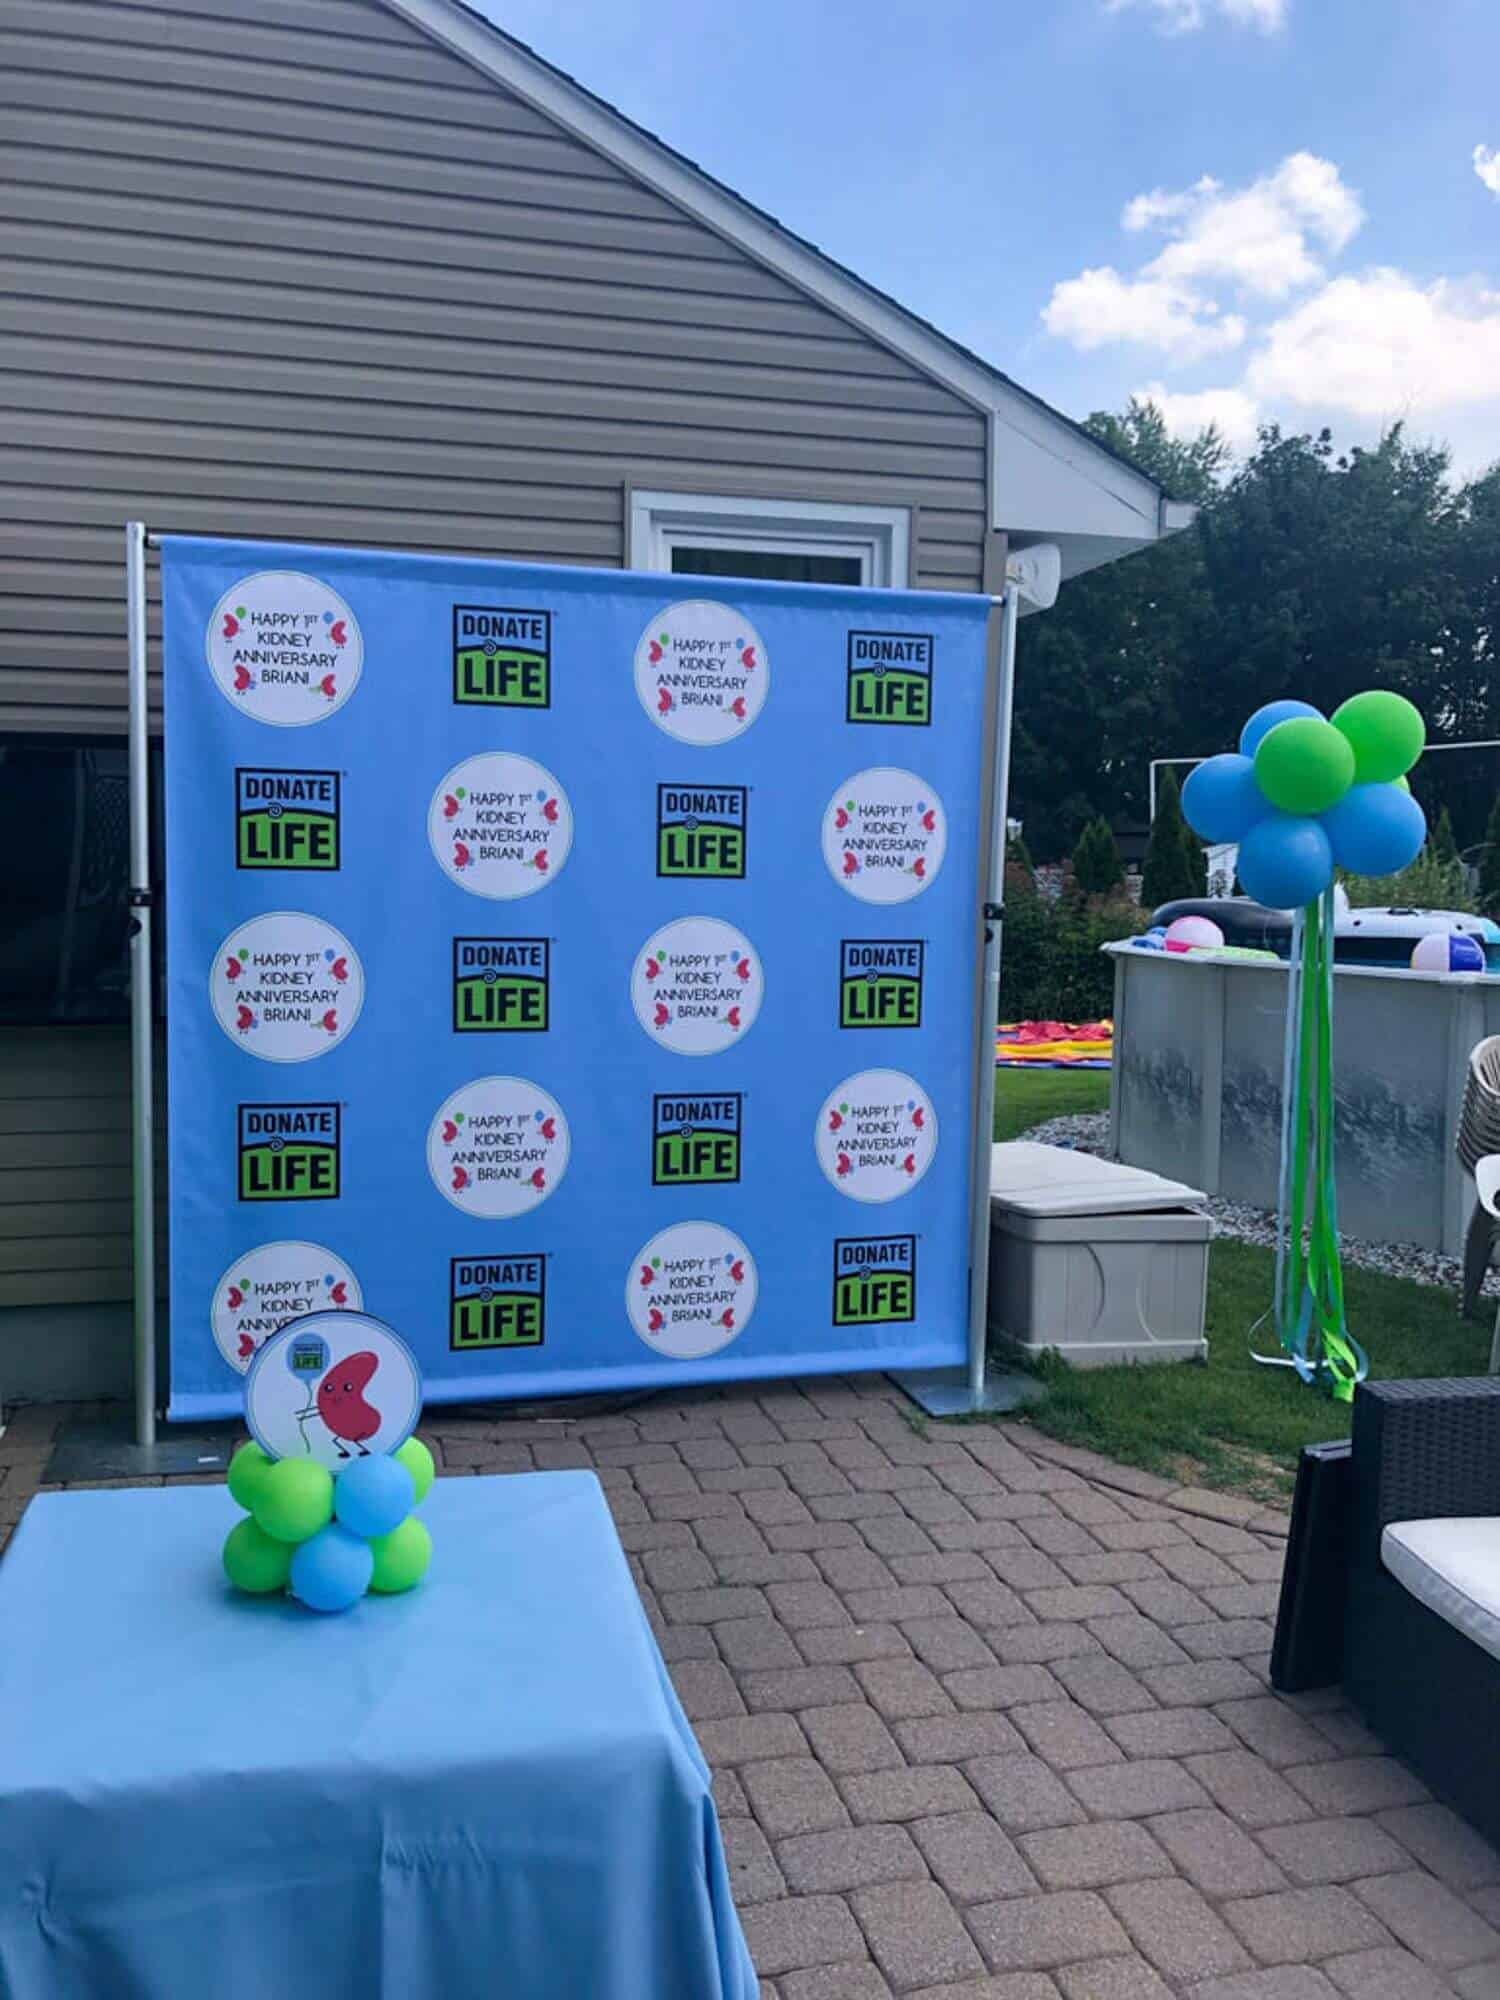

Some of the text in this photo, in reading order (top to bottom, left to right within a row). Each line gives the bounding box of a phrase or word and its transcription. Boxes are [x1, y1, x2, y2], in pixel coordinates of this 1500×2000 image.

[250, 612, 299, 626] HAPPY
[463, 615, 542, 640] DONATE
[257, 632, 312, 647] KIDNEY
[672, 639, 719, 652] HAPPY
[232, 649, 338, 667] ANNIVERSARY
[856, 640, 926, 662] DONATE
[678, 657, 726, 671] KIDNEY
[464, 658, 542, 697] LIFE
[656, 674, 747, 689] ANNIVERSARY
[856, 679, 924, 716] LIFE
[245, 777, 331, 800] DONATE
[469, 792, 514, 805] HAPPY
[666, 793, 739, 814] DONATE
[476, 812, 526, 824] KIDNEY
[858, 805, 897, 817] HAPPY
[453, 828, 550, 842] ANNIVERSARY
[863, 823, 907, 834] KIDNEY
[247, 822, 331, 860] LIFE
[842, 840, 928, 851] ANNIVERSARY
[667, 833, 739, 868] LIFE
[253, 954, 300, 966] HAPPY
[463, 946, 541, 966] DONATE
[669, 955, 711, 967] HAPPY
[849, 947, 917, 967] DONATE
[260, 972, 313, 985] KIDNEY
[675, 972, 721, 984] KIDNEY
[235, 990, 339, 1002] ANNIVERSARY
[653, 989, 742, 1000] ANNIVERSARY
[464, 987, 540, 1022] LIFE
[848, 986, 915, 1019] LIFE
[662, 1101, 733, 1122] DONATE
[851, 1106, 890, 1118] HAPPY
[248, 1113, 331, 1133] DONATE
[468, 1115, 512, 1128] HAPPY
[856, 1122, 898, 1134] KIDNEY
[473, 1133, 525, 1145] KIDNEY
[836, 1138, 917, 1151] ANNIVERSARY
[451, 1149, 547, 1163] ANNIVERSARY
[662, 1140, 732, 1176] LIFE
[249, 1154, 331, 1191] LIFE
[843, 1244, 908, 1264] DONATE
[664, 1258, 705, 1271] HAPPY
[460, 1264, 537, 1285] DONATE
[255, 1281, 300, 1295] HAPPY
[669, 1275, 715, 1289] KIDNEY
[261, 1298, 313, 1312] KIDNEY
[648, 1291, 736, 1306] ANNIVERSARY
[842, 1281, 907, 1316] LIFE
[460, 1303, 535, 1341] LIFE
